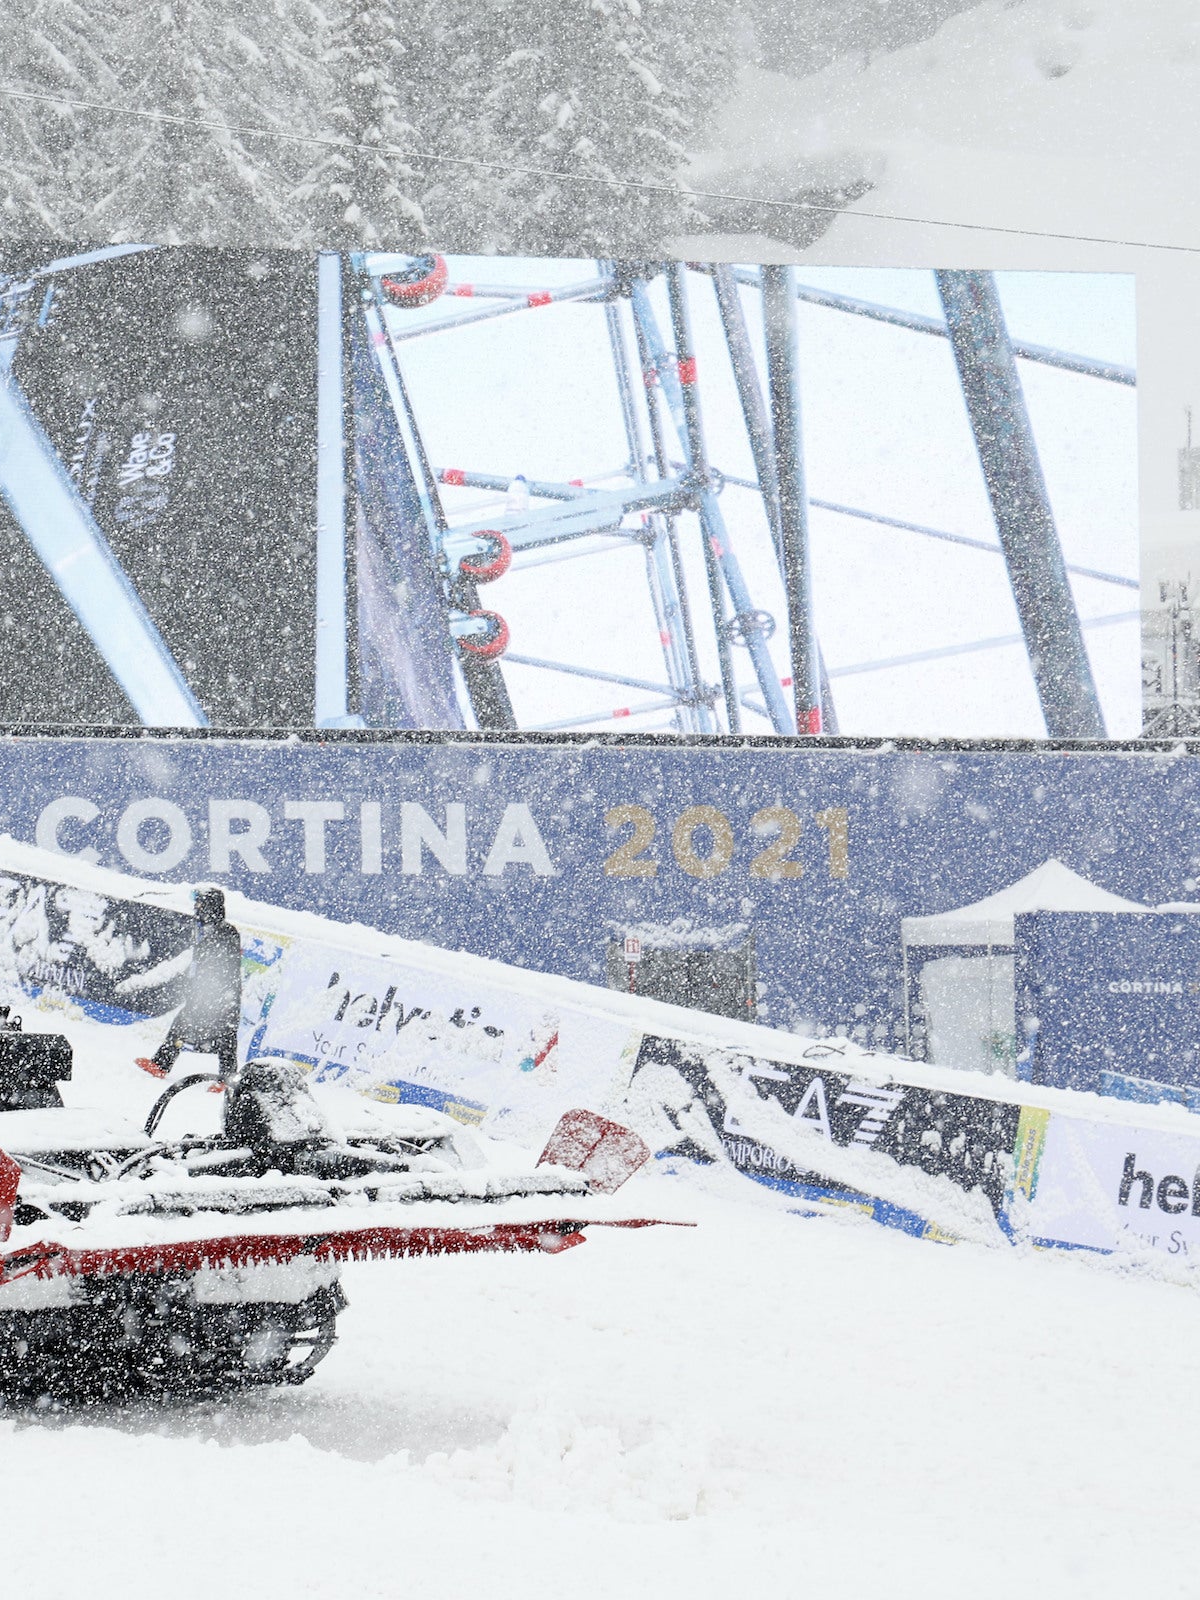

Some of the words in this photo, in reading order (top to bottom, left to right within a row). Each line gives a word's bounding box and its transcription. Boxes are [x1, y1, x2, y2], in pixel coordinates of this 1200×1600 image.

[118, 432, 151, 485] Wave
[36, 796, 555, 876] CORTINA
[602, 804, 850, 879] 2021
[1108, 981, 1184, 994] CORTINA
